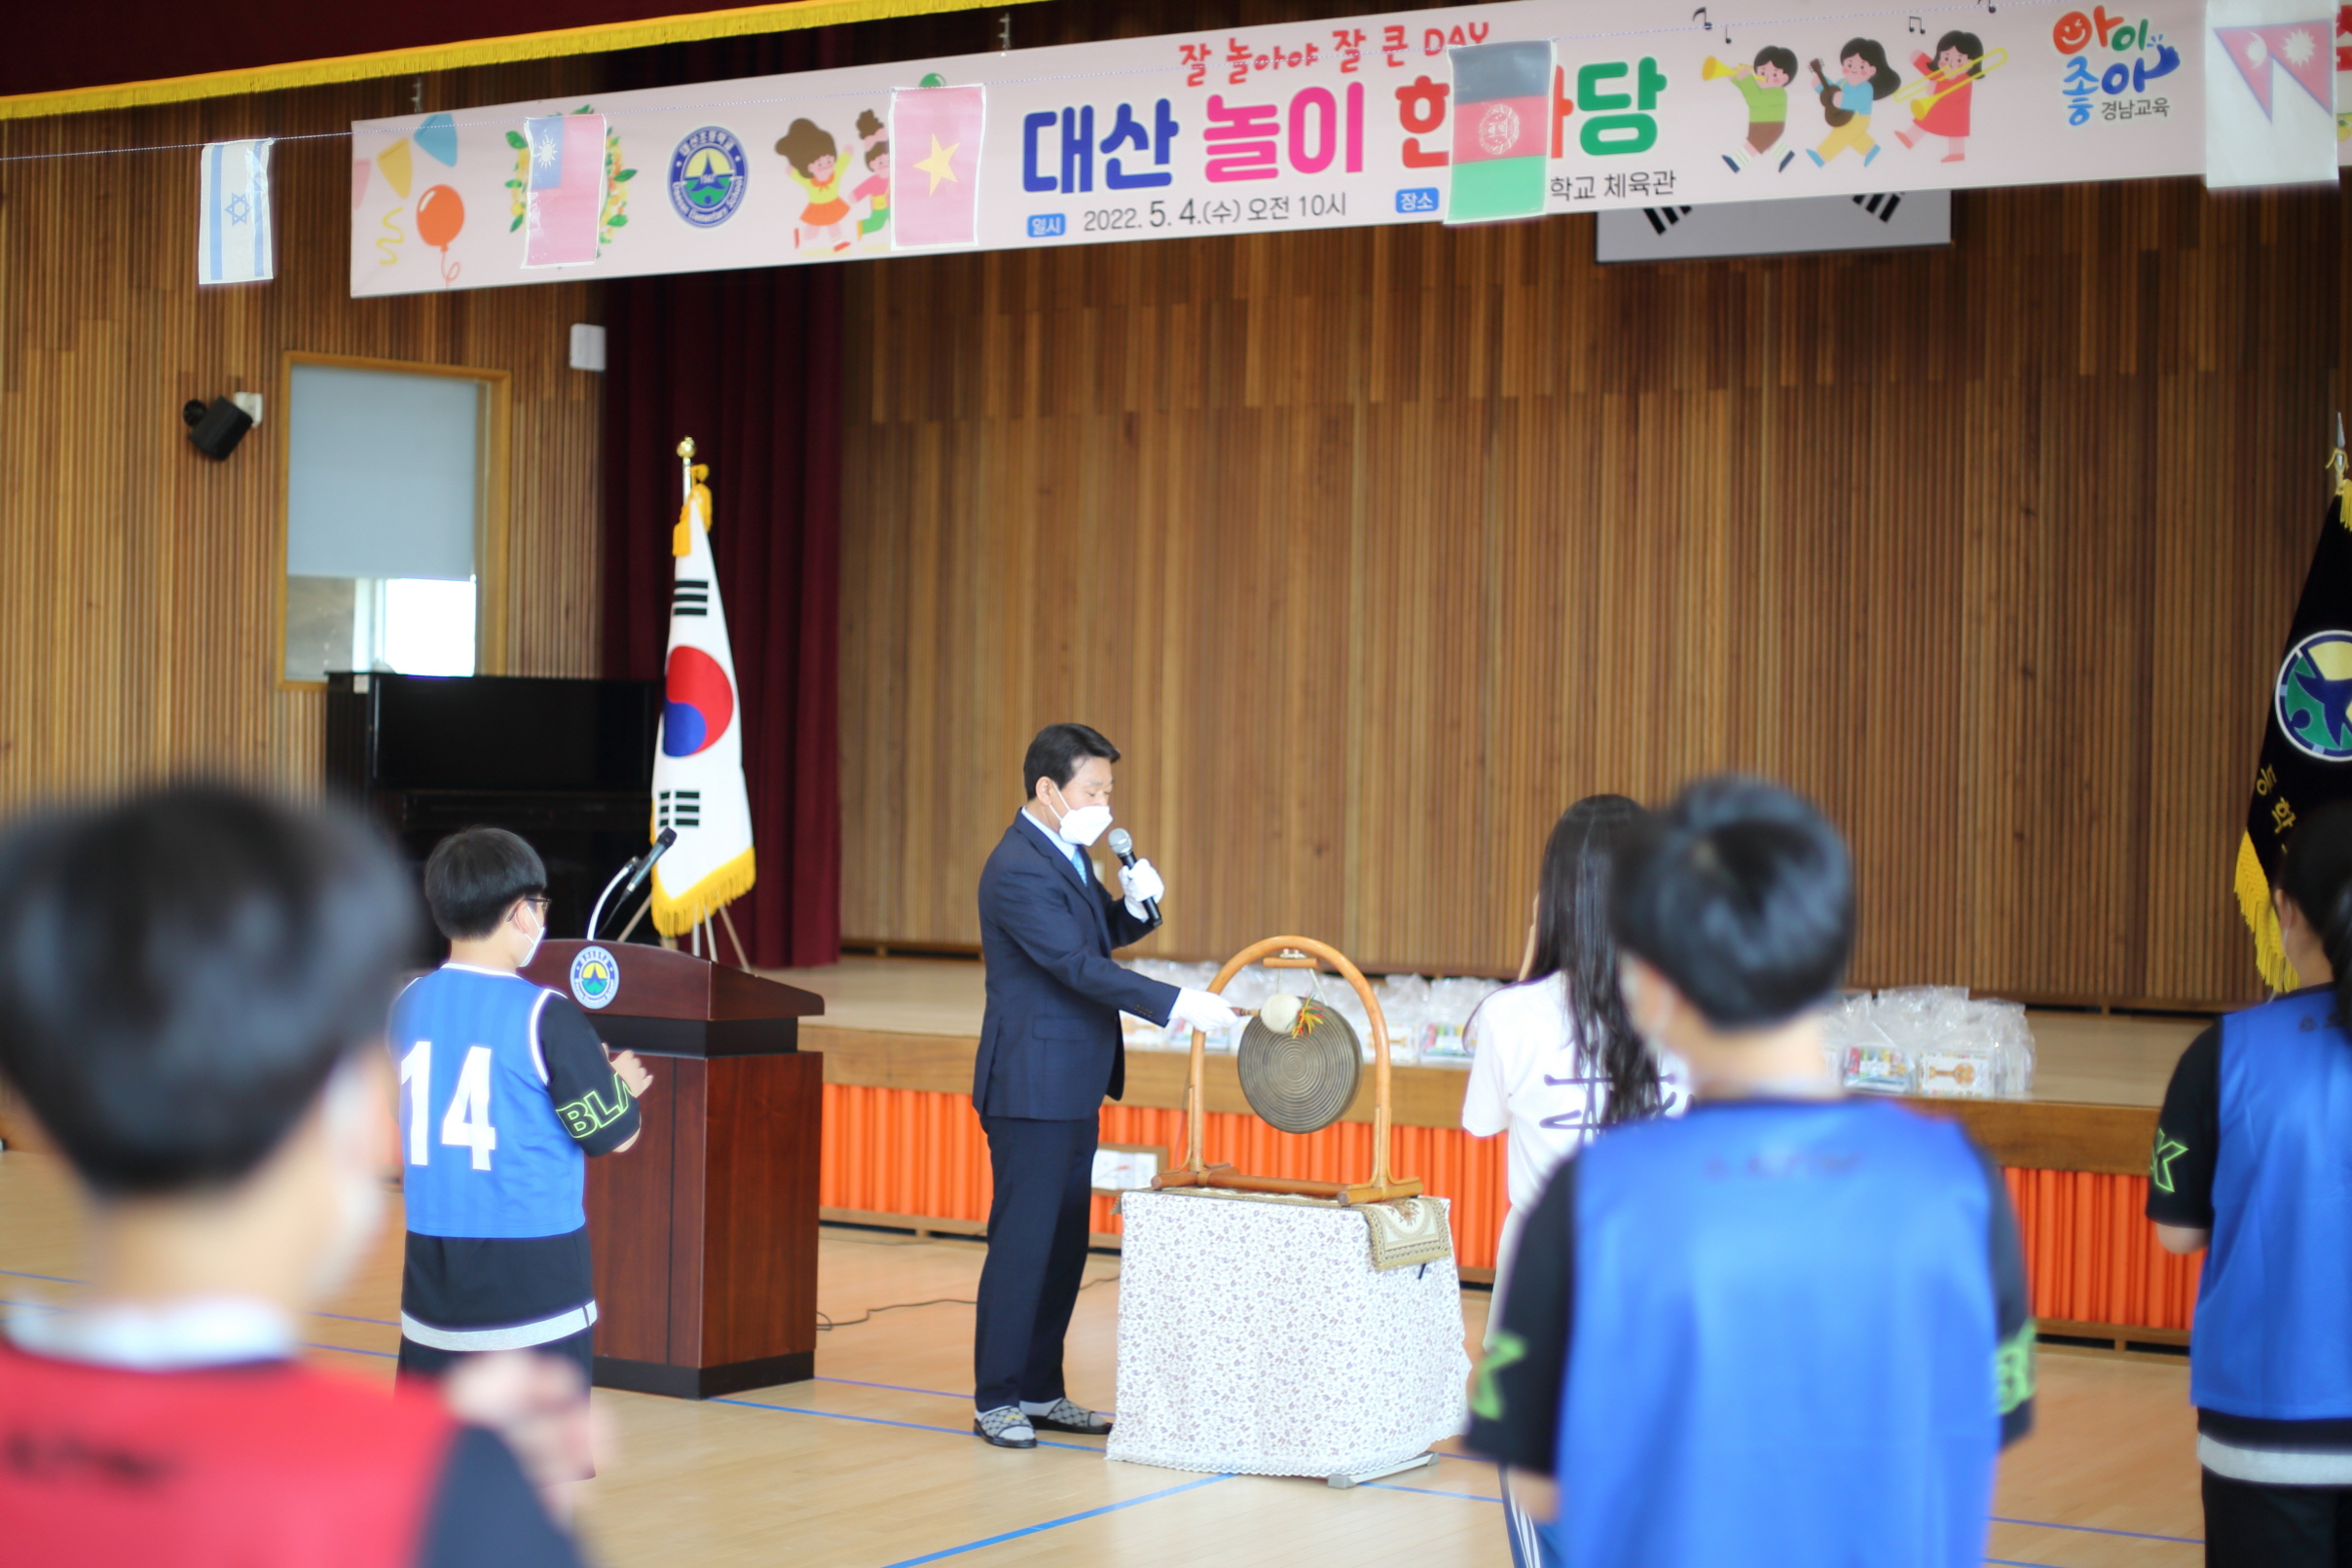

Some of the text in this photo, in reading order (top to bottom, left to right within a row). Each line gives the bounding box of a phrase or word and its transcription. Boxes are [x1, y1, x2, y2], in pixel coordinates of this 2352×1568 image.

[1179, 21, 1489, 87] 잘 놀아야 잘 큰 DAY
[1023, 55, 1668, 194] 대산 놀이 한당
[2101, 97, 2170, 121] 경남교육
[1032, 216, 1062, 236] 일시
[1083, 207, 1143, 232] 2022.
[1247, 195, 1290, 221] 오전
[1299, 192, 1346, 217] 10시
[1399, 191, 1435, 212] 장소
[1603, 169, 1676, 199] 체육관
[401, 1040, 496, 1172] 14
